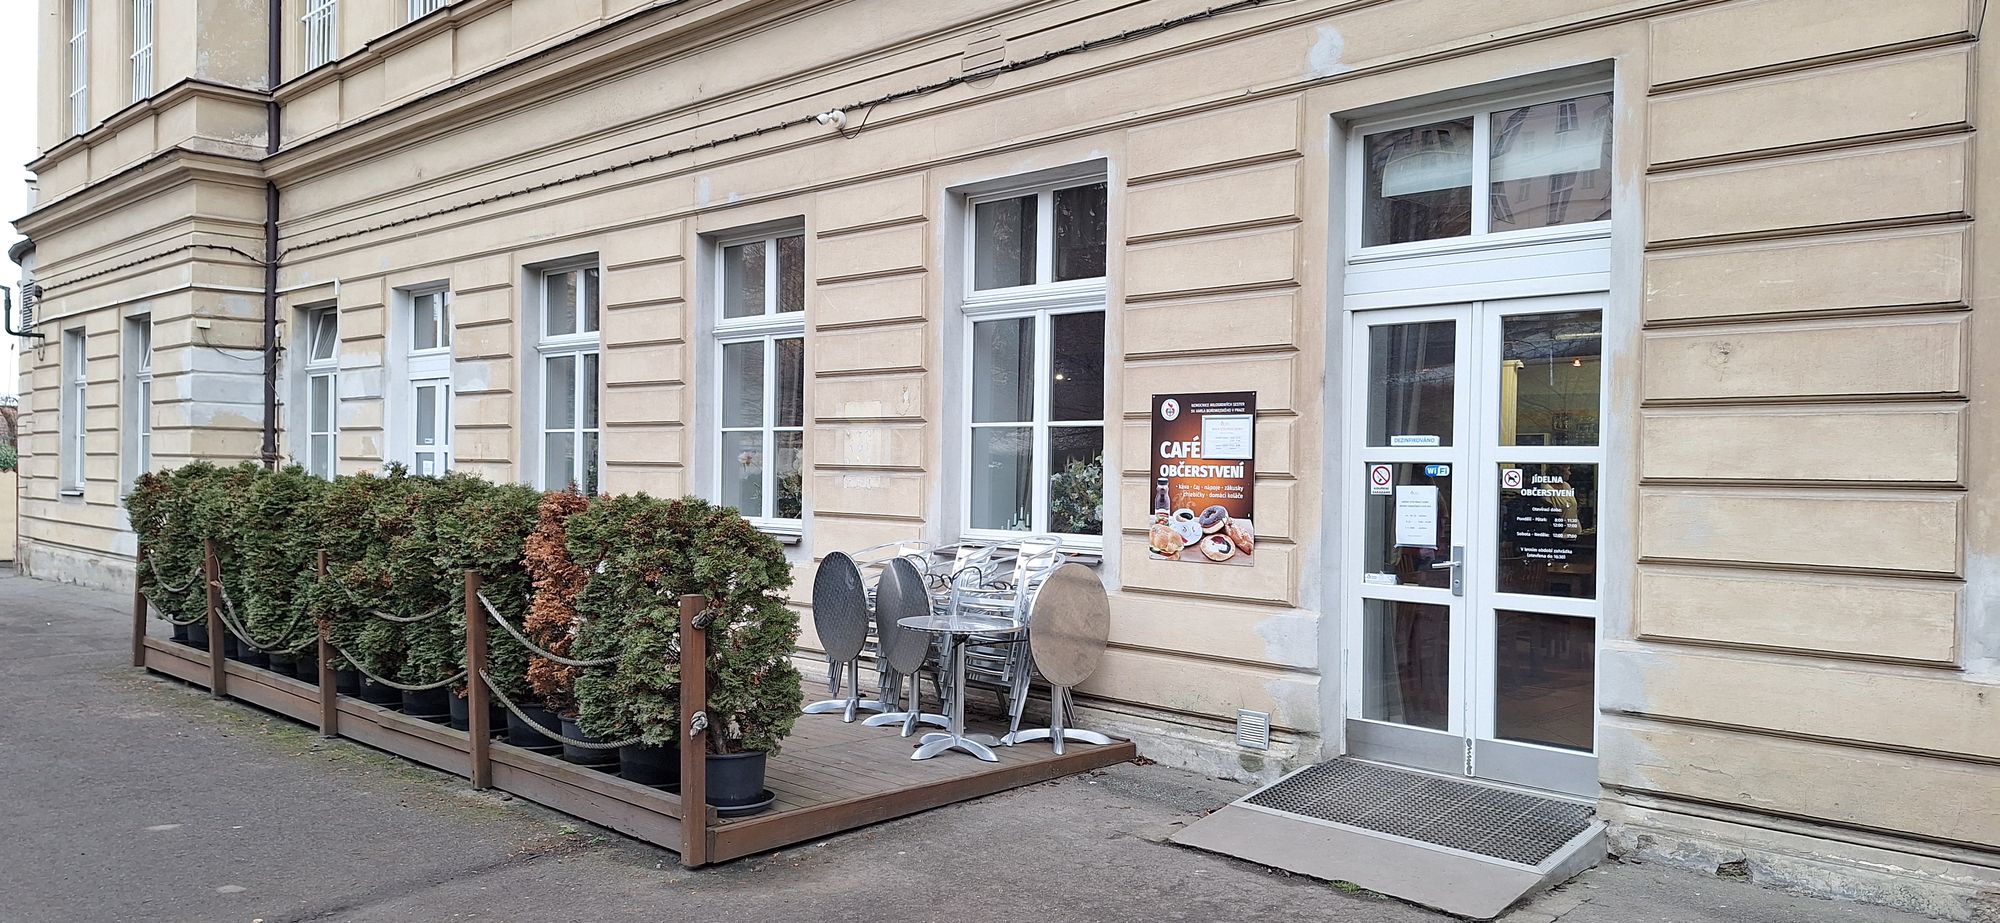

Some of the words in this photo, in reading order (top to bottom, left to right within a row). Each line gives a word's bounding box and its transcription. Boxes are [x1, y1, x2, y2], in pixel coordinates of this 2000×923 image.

[1160, 436, 1201, 458] CAFÉ
[1160, 461, 1244, 478] OBČERSTVENÍ
[1531, 474, 1563, 484] JÍDELNA
[1520, 487, 1575, 497] OBČERSTVENÍ
